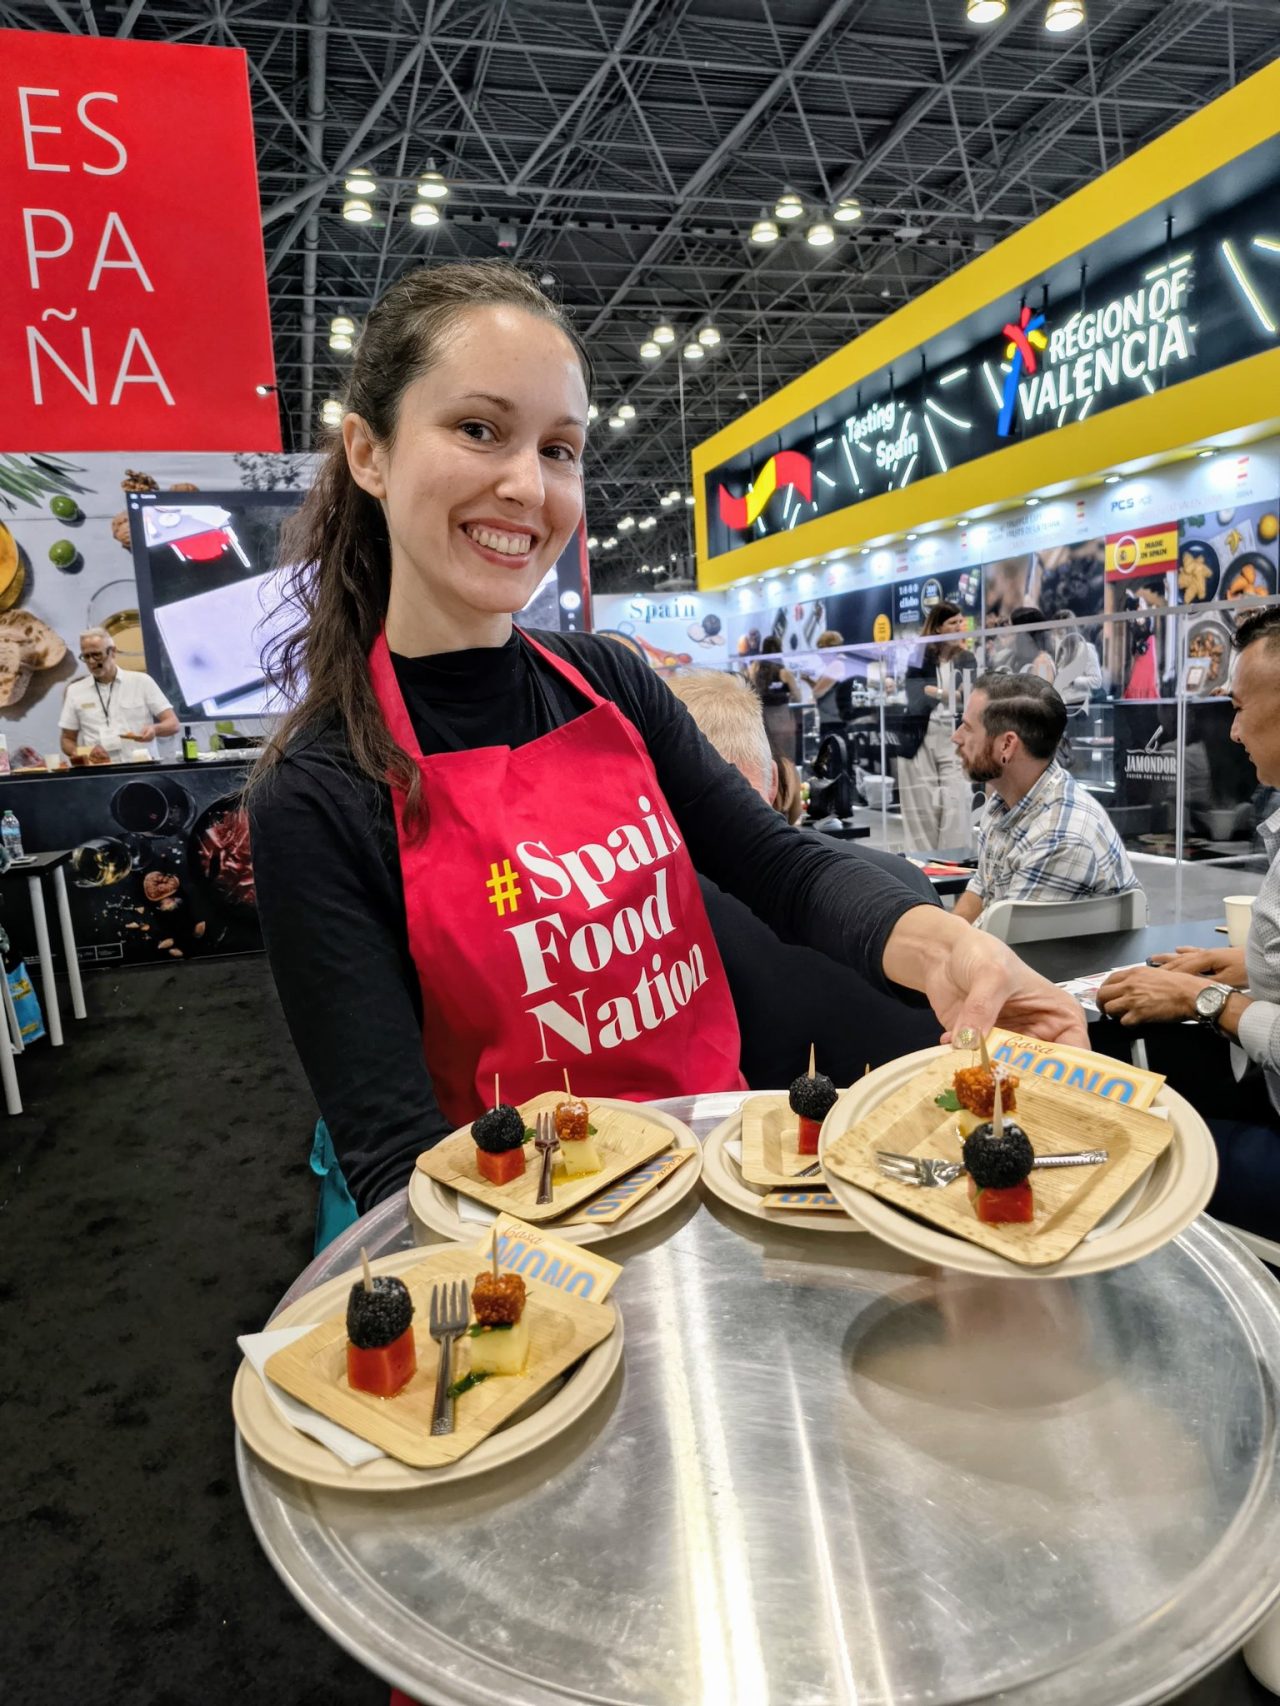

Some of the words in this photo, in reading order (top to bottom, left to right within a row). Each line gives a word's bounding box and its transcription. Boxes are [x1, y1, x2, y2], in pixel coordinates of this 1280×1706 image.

[18, 86, 128, 176] ES
[22, 207, 155, 292] PA
[1149, 268, 1188, 322] OF
[26, 307, 176, 406] ÑA
[1018, 315, 1188, 420] VALENCIA
[845, 402, 895, 443] Tasting
[876, 432, 919, 470] Spain
[1145, 540, 1163, 549] MADE
[629, 598, 695, 623] Spain
[1124, 755, 1177, 775] JAMONDOR
[504, 868, 677, 998] Food
[525, 944, 709, 1064] Nation
